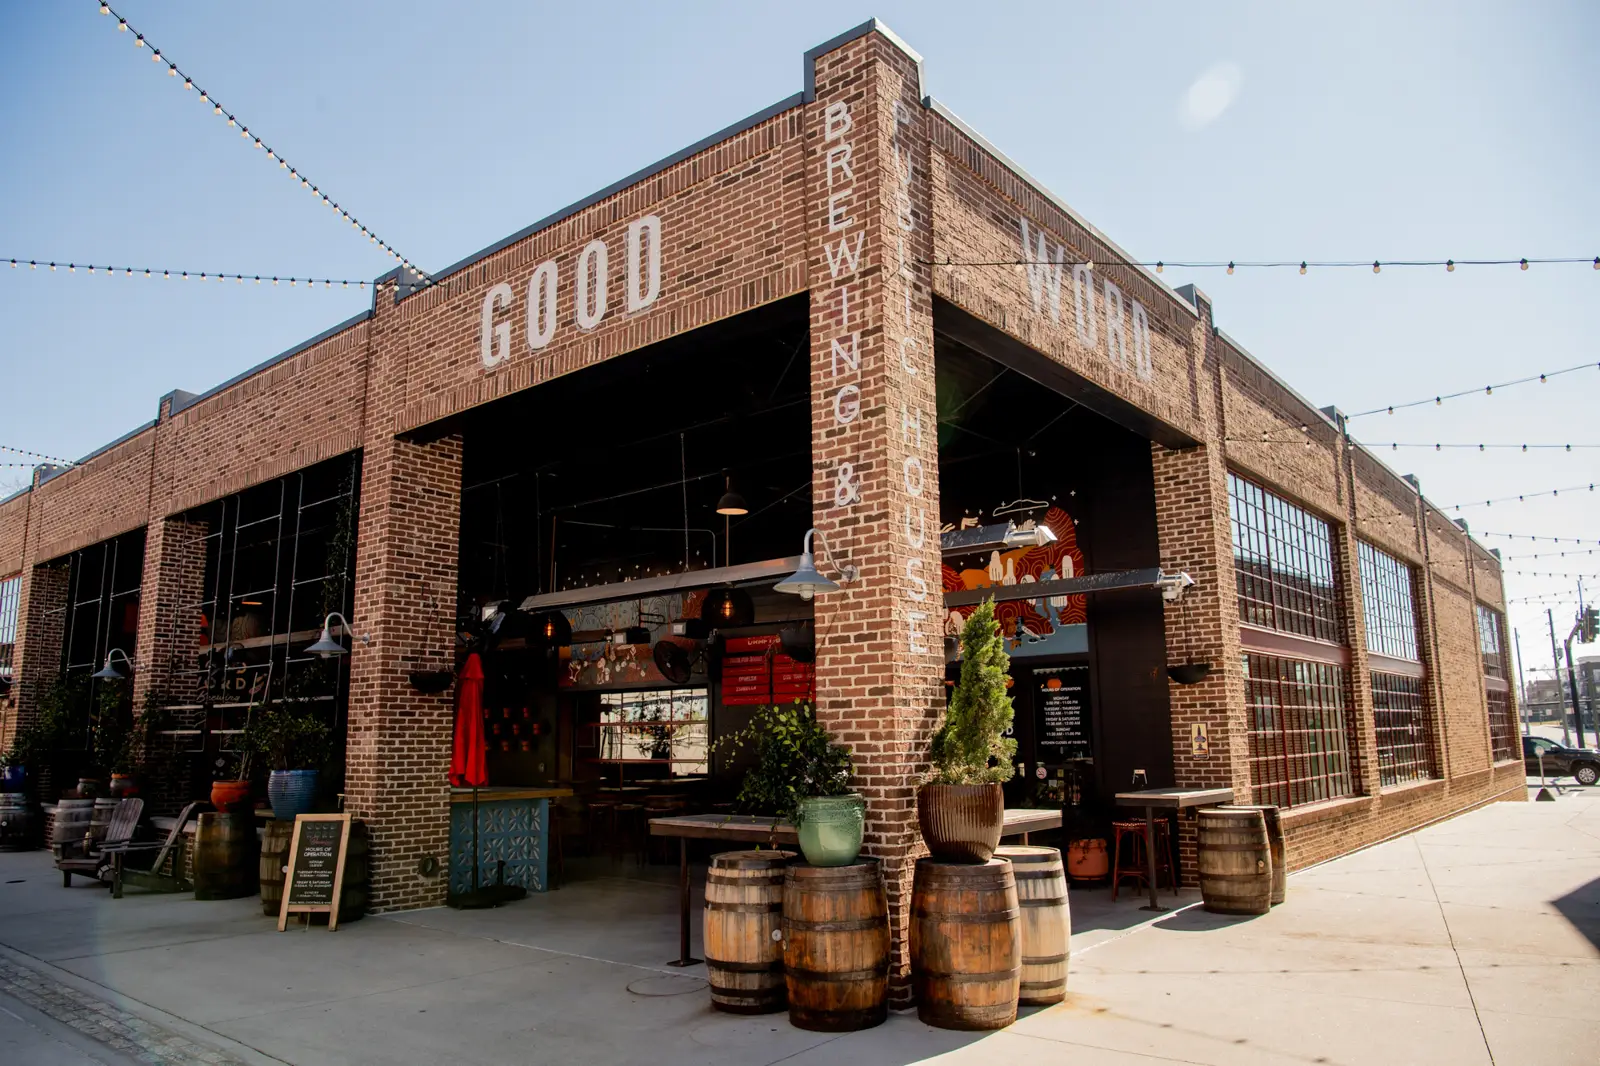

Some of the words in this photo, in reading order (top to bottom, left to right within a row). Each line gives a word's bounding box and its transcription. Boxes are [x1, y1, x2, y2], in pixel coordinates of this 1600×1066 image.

[481, 214, 661, 369] GOOD
[824, 100, 865, 423] BREWING
[893, 101, 917, 375] PUBLIC
[1020, 216, 1153, 383] WORD
[835, 462, 860, 506] &
[903, 407, 927, 654] HOUSE
